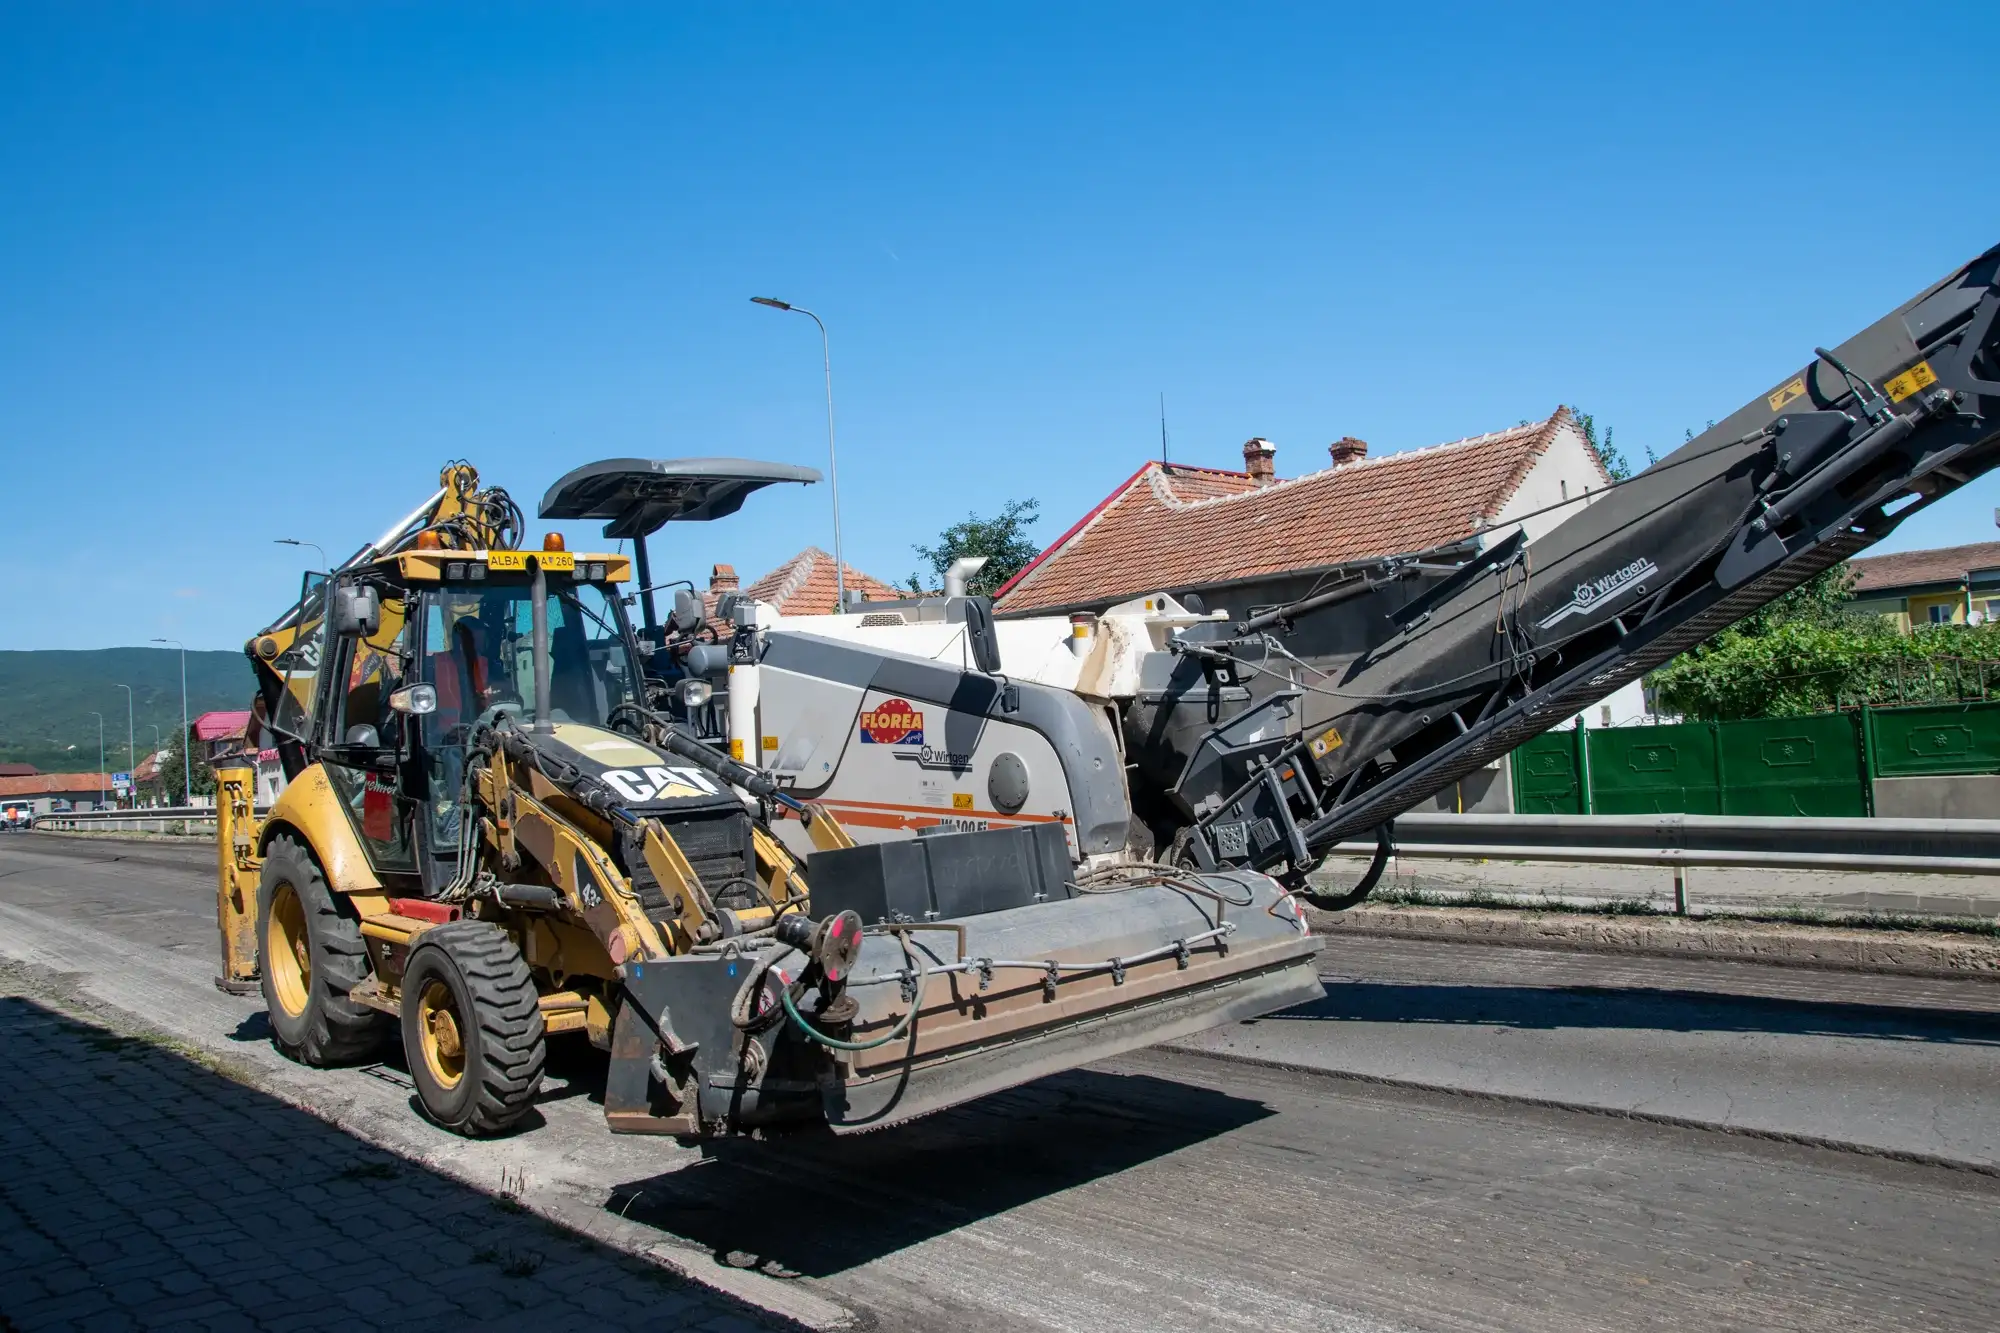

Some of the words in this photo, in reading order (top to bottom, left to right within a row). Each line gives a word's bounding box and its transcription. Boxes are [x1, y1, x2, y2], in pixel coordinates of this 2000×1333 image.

[491, 555, 519, 566] ALBA
[555, 556, 573, 566] 260
[1593, 557, 1648, 593] Wirtgen
[861, 713, 923, 729] FLOREA
[933, 751, 969, 765] Wirtgen
[601, 766, 719, 802] CAT
